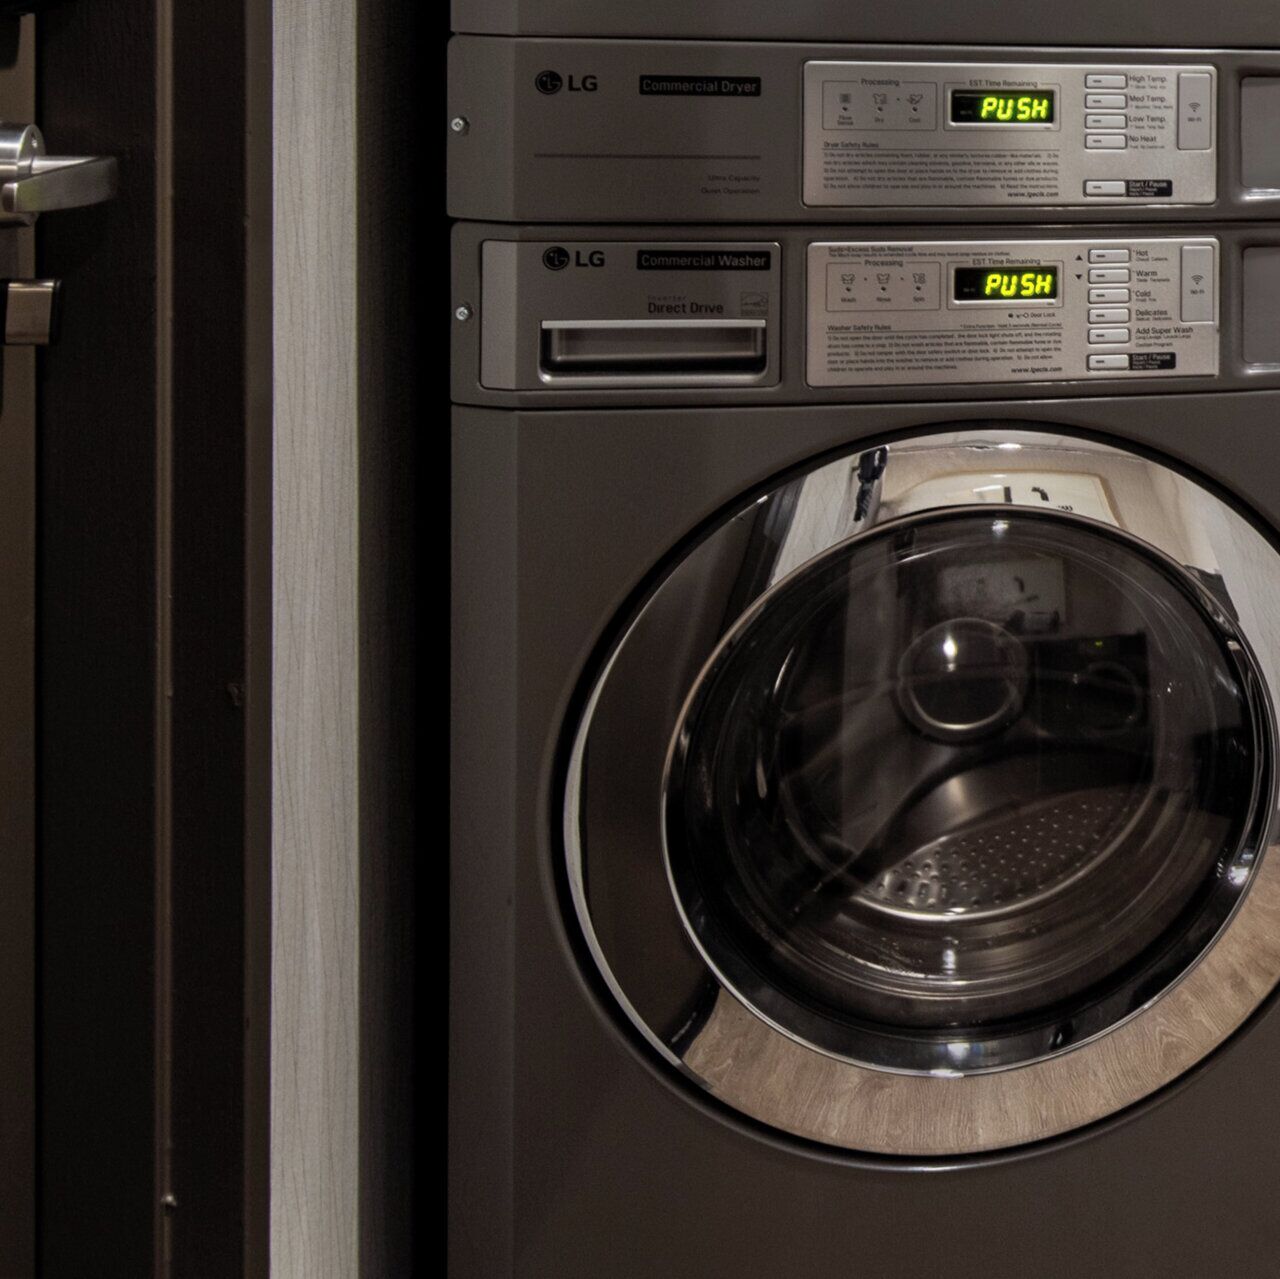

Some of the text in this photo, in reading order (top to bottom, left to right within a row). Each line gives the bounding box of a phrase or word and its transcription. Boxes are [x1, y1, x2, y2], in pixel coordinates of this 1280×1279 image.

[568, 75, 598, 92] LG
[861, 78, 900, 87] Processing
[1129, 74, 1146, 84] High
[642, 79, 757, 95] Commercial Dryer
[985, 79, 1001, 87] Time
[1002, 80, 1038, 89] Remaining
[1129, 95, 1145, 103] Med
[981, 97, 1049, 121] PUSH
[1129, 115, 1145, 123] Low
[1129, 135, 1157, 143] No Heat
[1136, 249, 1148, 257] Hot
[575, 251, 605, 267] LG
[641, 254, 767, 267] Commercial Washer
[864, 259, 903, 267] Processing
[1005, 258, 1041, 266] Remaining
[985, 273, 1052, 297] PUSH
[648, 302, 724, 314] Direct Drive
[853, 324, 873, 332] Safety
[1151, 326, 1173, 335] Super
[1174, 326, 1193, 334] Wash
